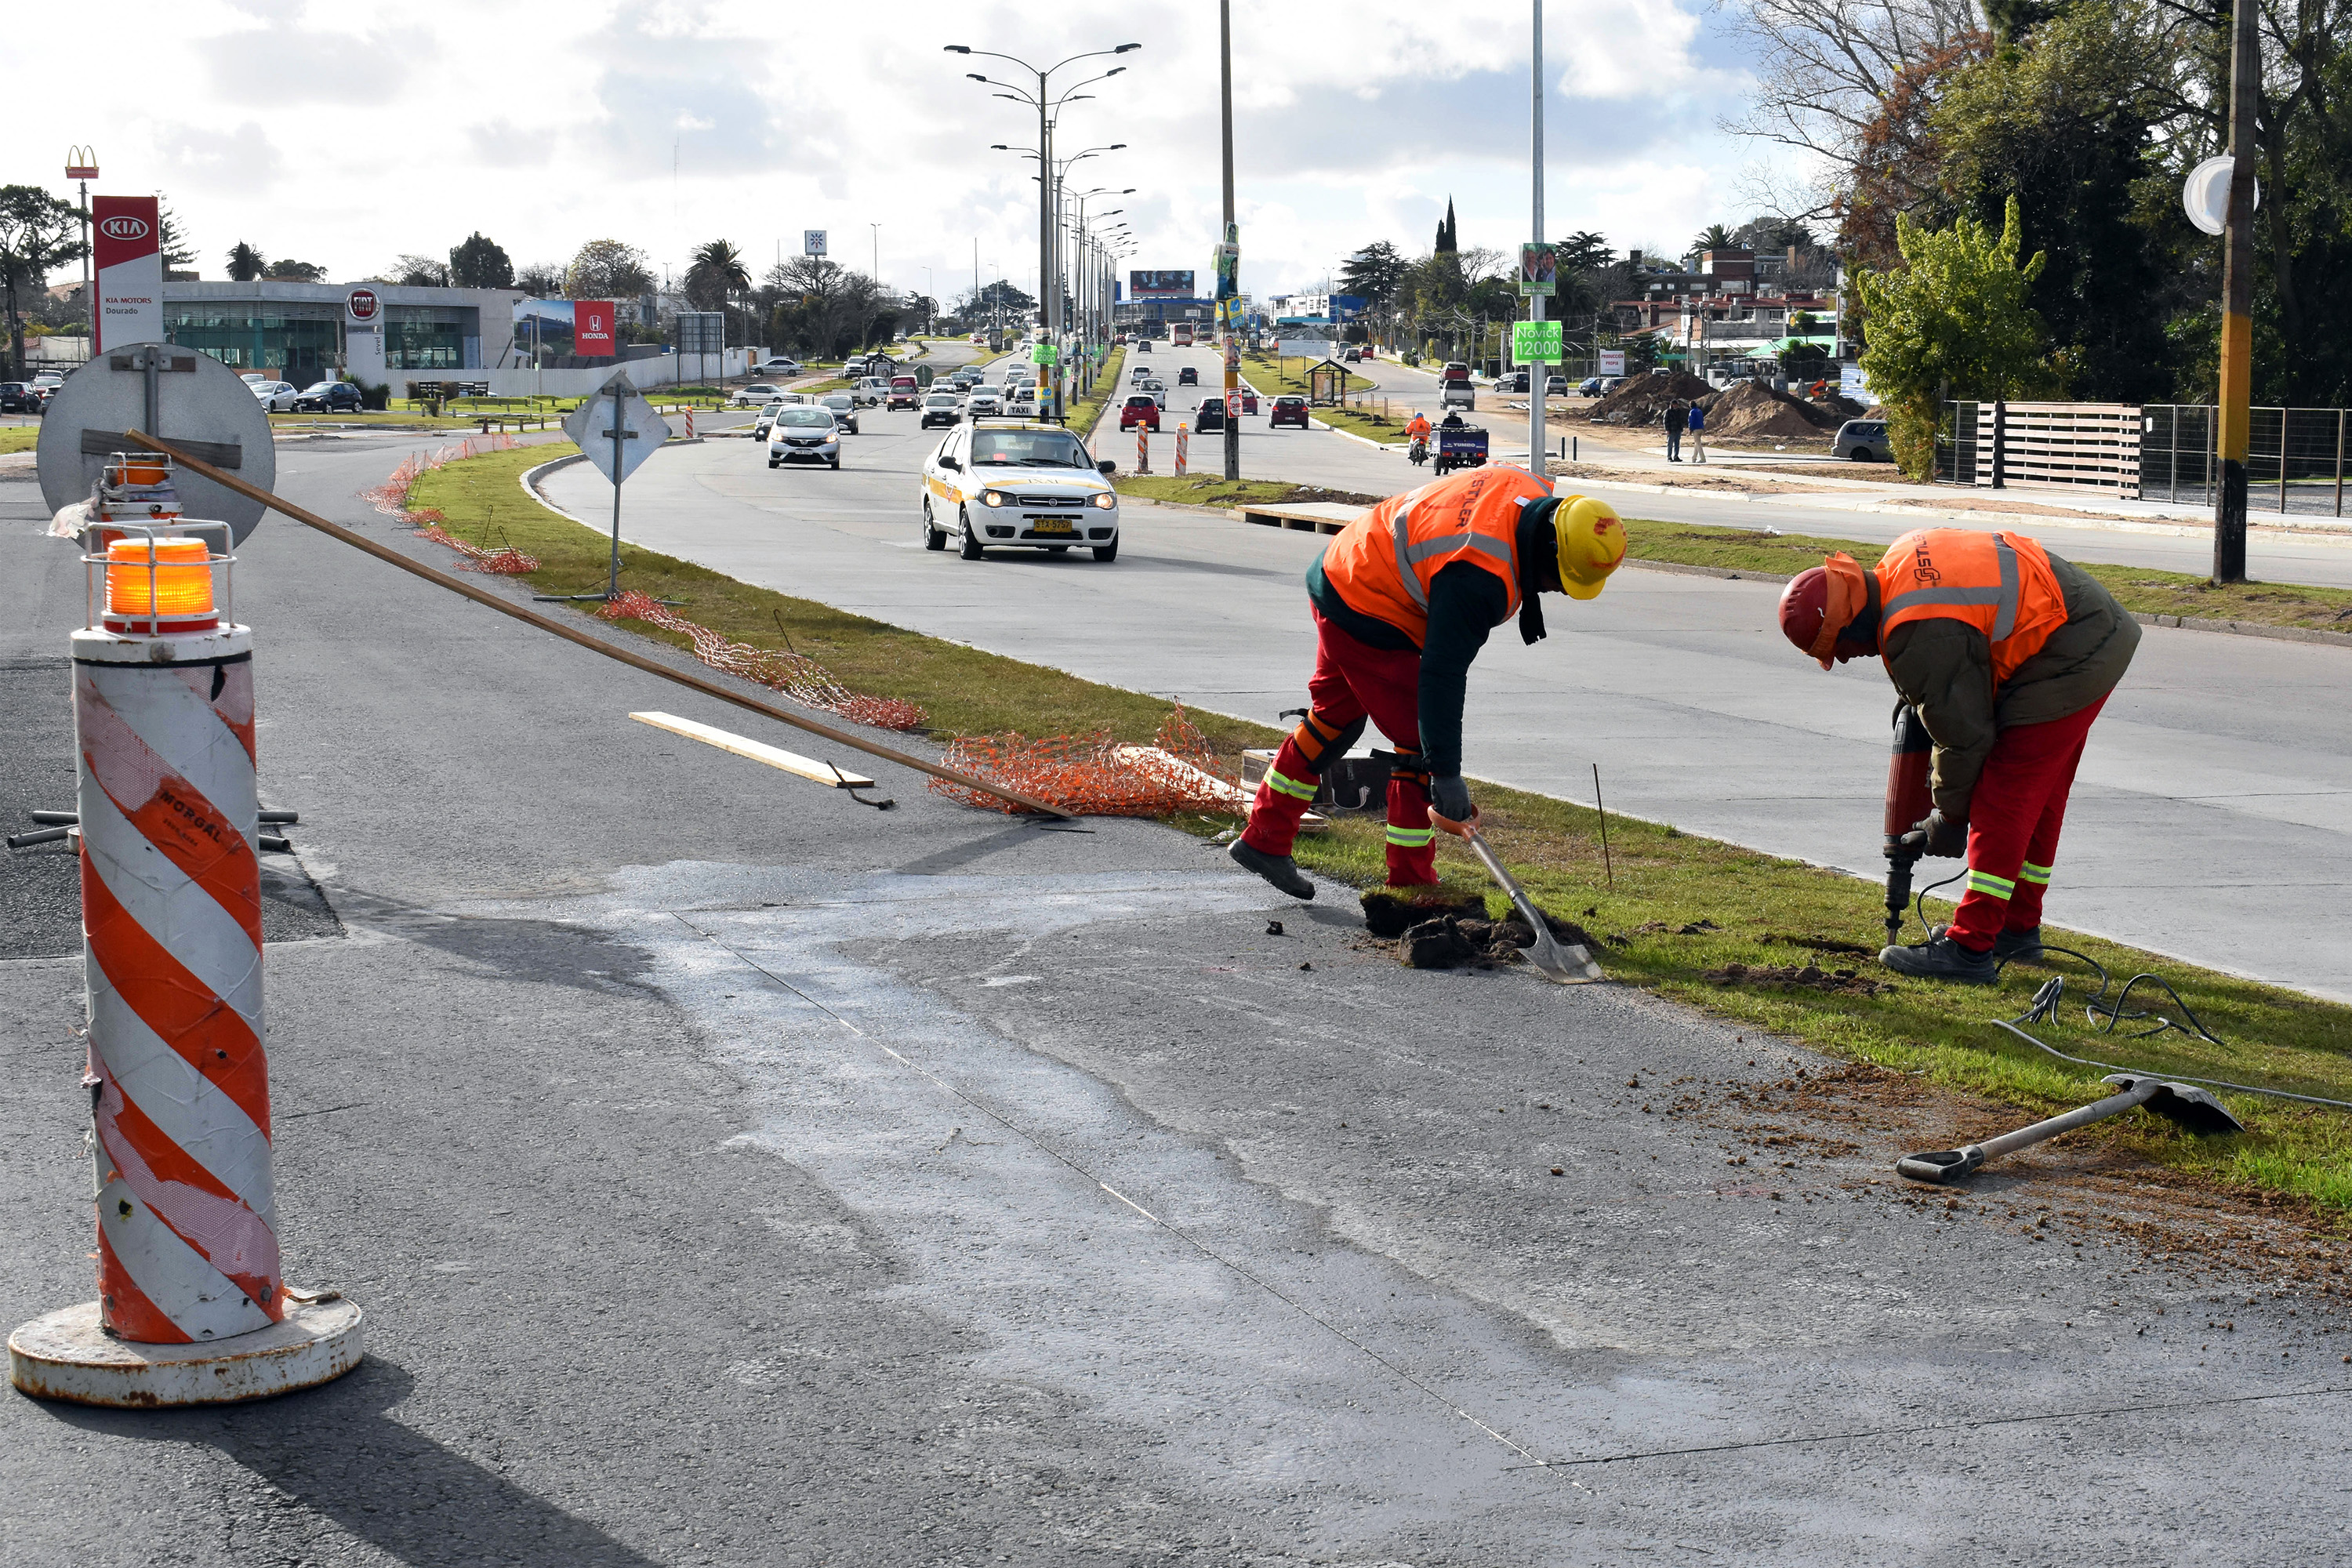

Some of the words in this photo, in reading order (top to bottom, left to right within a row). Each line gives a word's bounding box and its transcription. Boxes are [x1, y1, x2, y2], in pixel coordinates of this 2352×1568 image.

[110, 221, 142, 234] KIA
[354, 296, 372, 312] FIAT
[1516, 326, 1559, 338] Novick
[1517, 340, 1559, 355] 12000
[1456, 480, 1484, 528] STILER
[160, 791, 221, 844] MORGAL
